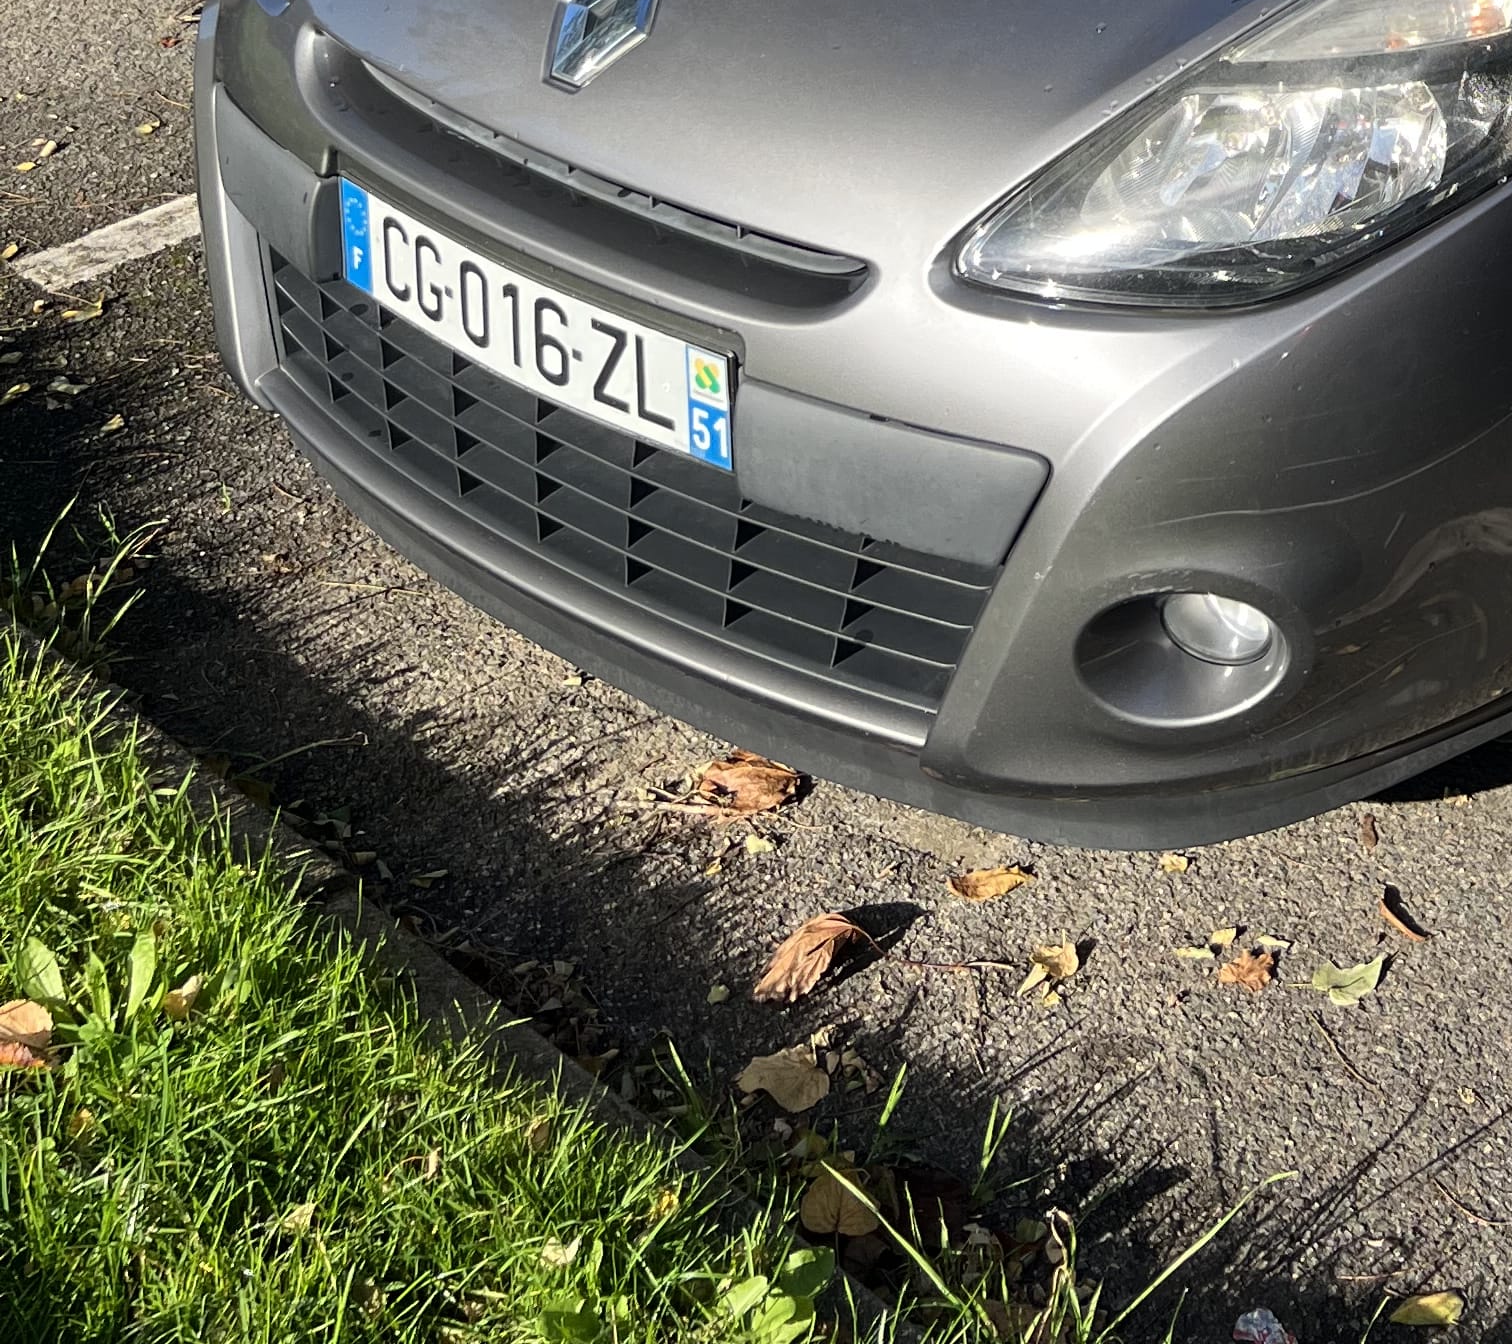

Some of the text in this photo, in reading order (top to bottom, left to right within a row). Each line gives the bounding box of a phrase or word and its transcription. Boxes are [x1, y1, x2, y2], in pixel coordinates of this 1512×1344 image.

[352, 245, 364, 270] F
[382, 215, 676, 432] CG-016-ZL
[693, 407, 729, 459] 51
